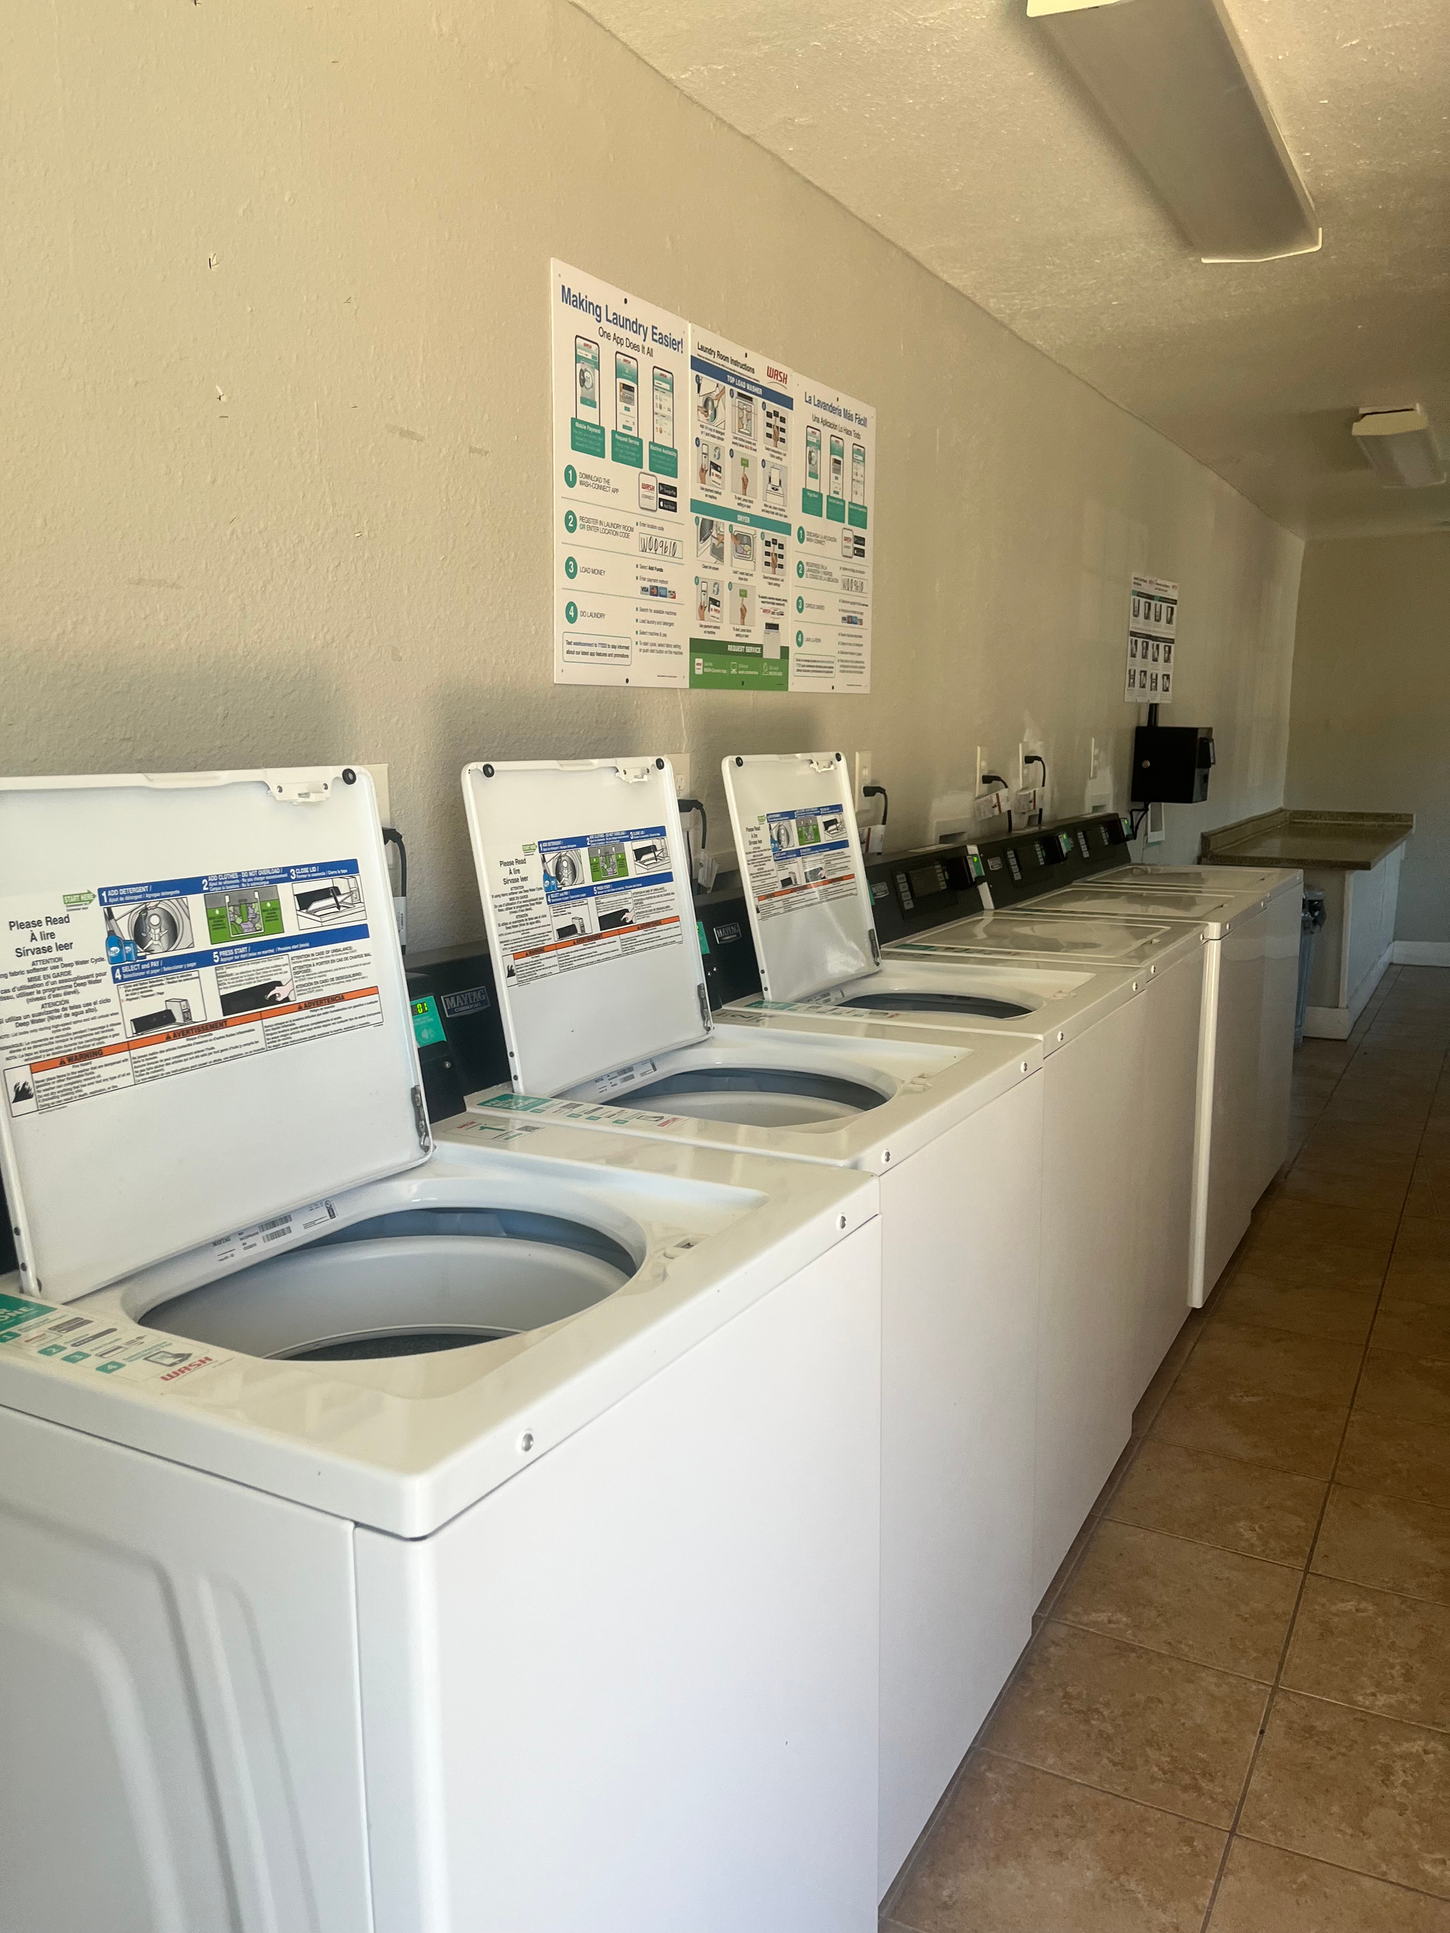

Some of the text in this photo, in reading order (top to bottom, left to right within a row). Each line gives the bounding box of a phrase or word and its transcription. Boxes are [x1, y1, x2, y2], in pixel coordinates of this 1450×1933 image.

[561, 284, 684, 354] Making Laundry Easier!
[598, 326, 654, 358] One App Does It All
[697, 341, 716, 359] Laundry
[716, 350, 730, 364] Room
[730, 356, 755, 375] Instructions
[727, 374, 735, 384] TOP
[735, 378, 746, 389] LOAD
[766, 365, 788, 385] WASH
[804, 391, 812, 405] La
[813, 394, 842, 418] Lavandería
[587, 424, 601, 435] Payment
[568, 469, 611, 486] 1 DOWNLOAD THE
[568, 514, 574, 527] 2
[579, 515, 599, 526] REGISTER
[603, 520, 622, 530] LAUNDRY
[622, 524, 634, 533] ROOM
[586, 524, 599, 534] ENTER
[599, 527, 619, 538] LOCATION
[619, 531, 631, 540] CODE
[568, 560, 606, 576] 3 LOAD MONEY
[798, 564, 803, 574] 2
[798, 599, 803, 609] 3
[569, 605, 606, 620] 4 DO LAUNDRY
[727, 644, 762, 654] REQUEST SERVICE
[514, 857, 527, 865] Read
[201, 879, 209, 891] 2
[218, 872, 239, 880] CLOTHES
[289, 868, 296, 880] 3
[64, 895, 80, 903] START
[101, 890, 108, 903] 1
[107, 889, 119, 897] ADD
[119, 885, 149, 895] DETERGENT
[8, 914, 71, 931] Please Read
[30, 930, 56, 943] À lire
[15, 941, 74, 958] Sírvase leer
[212, 946, 248, 963] 5 PRESS START
[8, 969, 25, 978] fabric
[26, 966, 49, 975] softener
[60, 961, 75, 969] Deep
[90, 956, 106, 965] Cycle.
[31, 956, 63, 967] ATTENTION
[27, 969, 72, 983] MISE EN GARDE
[95, 971, 107, 979] pour
[114, 968, 122, 980] 4
[121, 964, 141, 973] SELECT
[141, 962, 150, 970] and
[150, 960, 160, 969] PAY
[42, 984, 73, 995] programme
[73, 980, 87, 988] Deep
[41, 998, 70, 1010] ATENCIÓN
[98, 997, 112, 1005] ciclo
[303, 994, 345, 1010] ADVERTENCIA
[444, 989, 486, 1010] MAYTAG
[15, 1020, 30, 1028] Deep
[71, 1009, 84, 1018] agua
[172, 1020, 228, 1039] AVERTISSEMENT
[66, 1048, 104, 1065] WARNING
[160, 1356, 213, 1382] WASH
